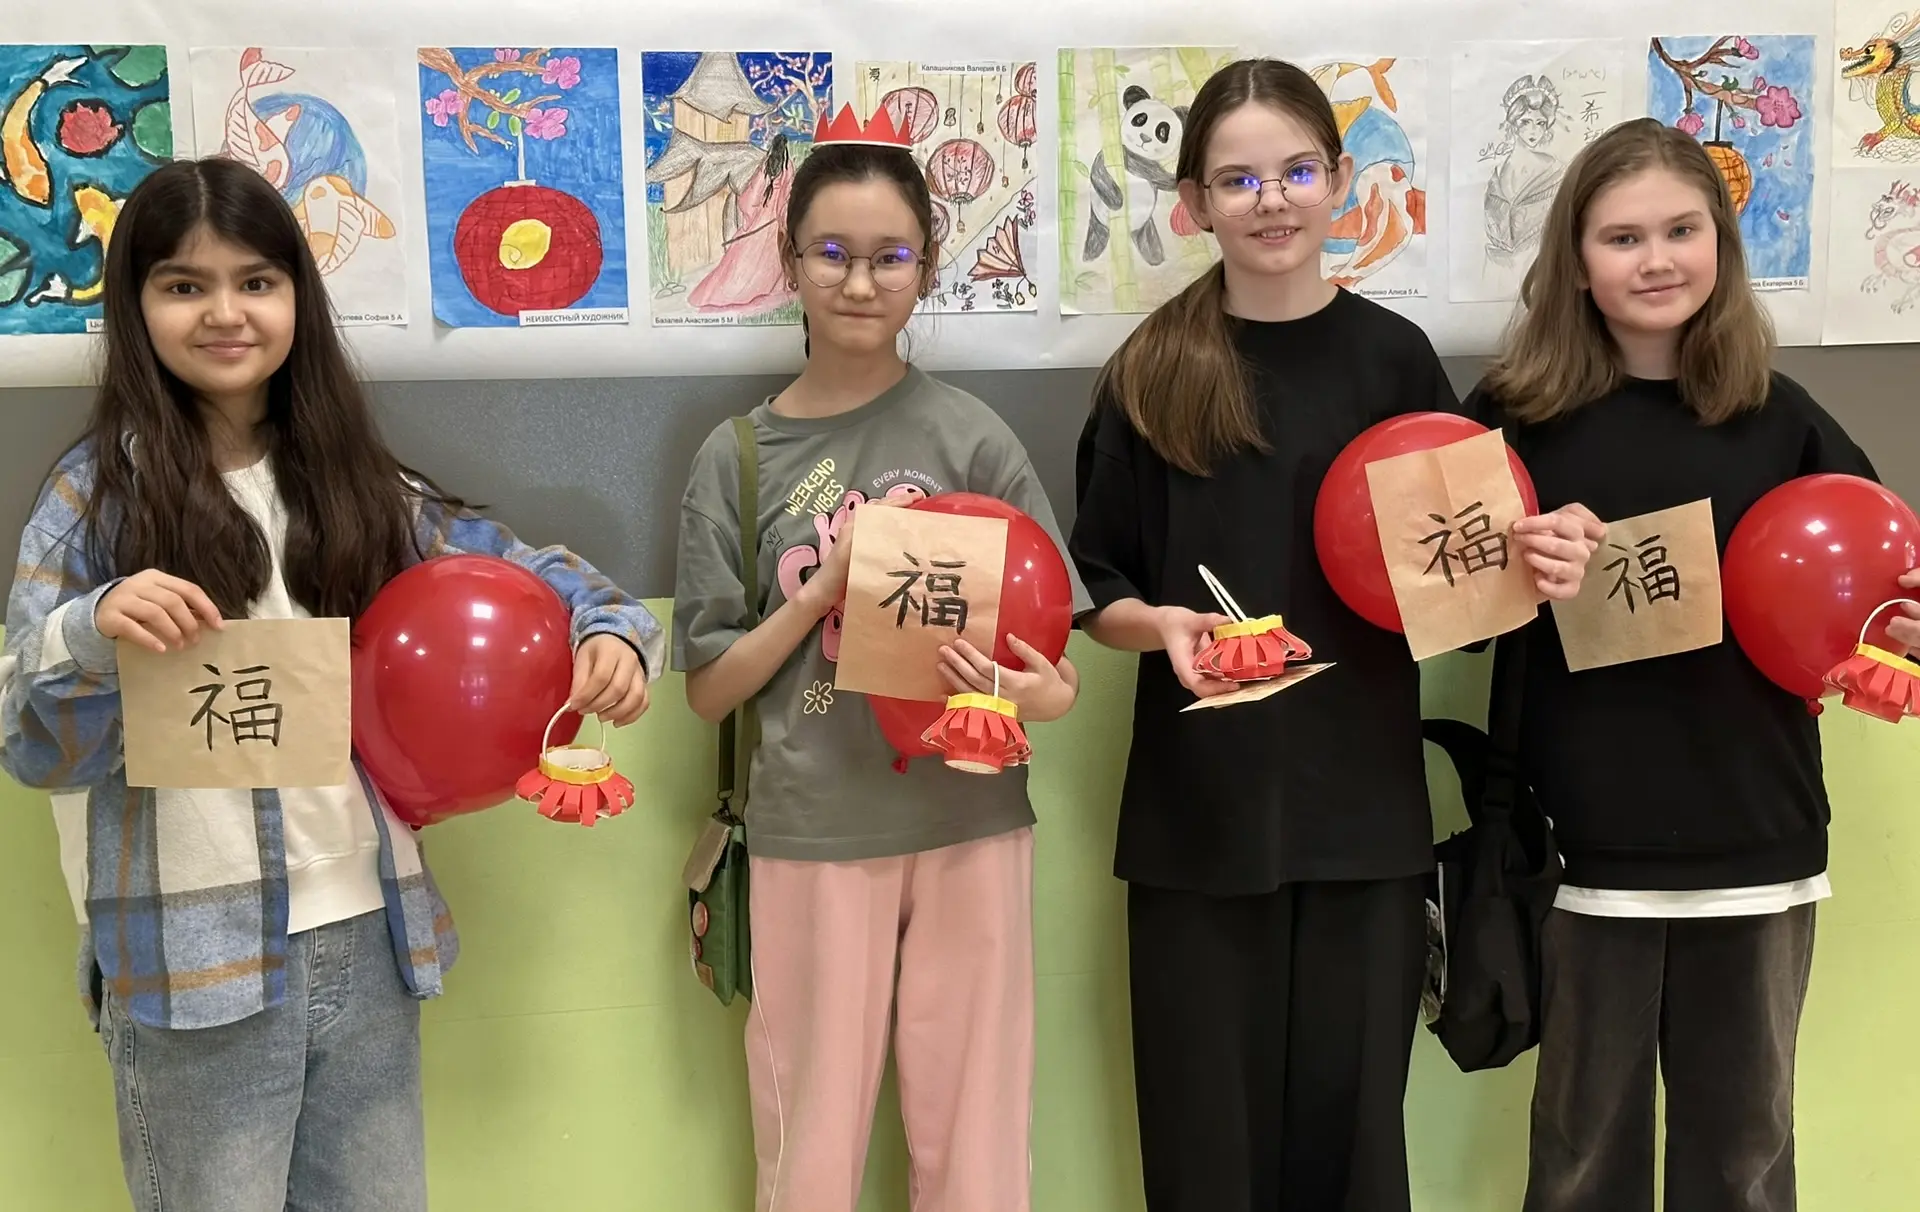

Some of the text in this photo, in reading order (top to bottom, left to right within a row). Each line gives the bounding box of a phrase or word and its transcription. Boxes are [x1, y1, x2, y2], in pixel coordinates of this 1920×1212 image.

[921, 64, 966, 72] Калашникова
[966, 64, 995, 73] Валерия
[1388, 288, 1407, 296] Алиса
[1762, 280, 1793, 288] Екатерина
[364, 314, 390, 322] София
[525, 313, 625, 323] НЕИЗВЕСТНЫЙ ХУДОЖНИК
[784, 457, 836, 517] WEEKEND
[872, 468, 943, 493] EVERY MOMENT
[806, 479, 845, 516] VIBES
[1417, 500, 1508, 588] 福
[1602, 534, 1680, 614] 福
[878, 551, 969, 635] 福
[188, 663, 283, 752] 福
